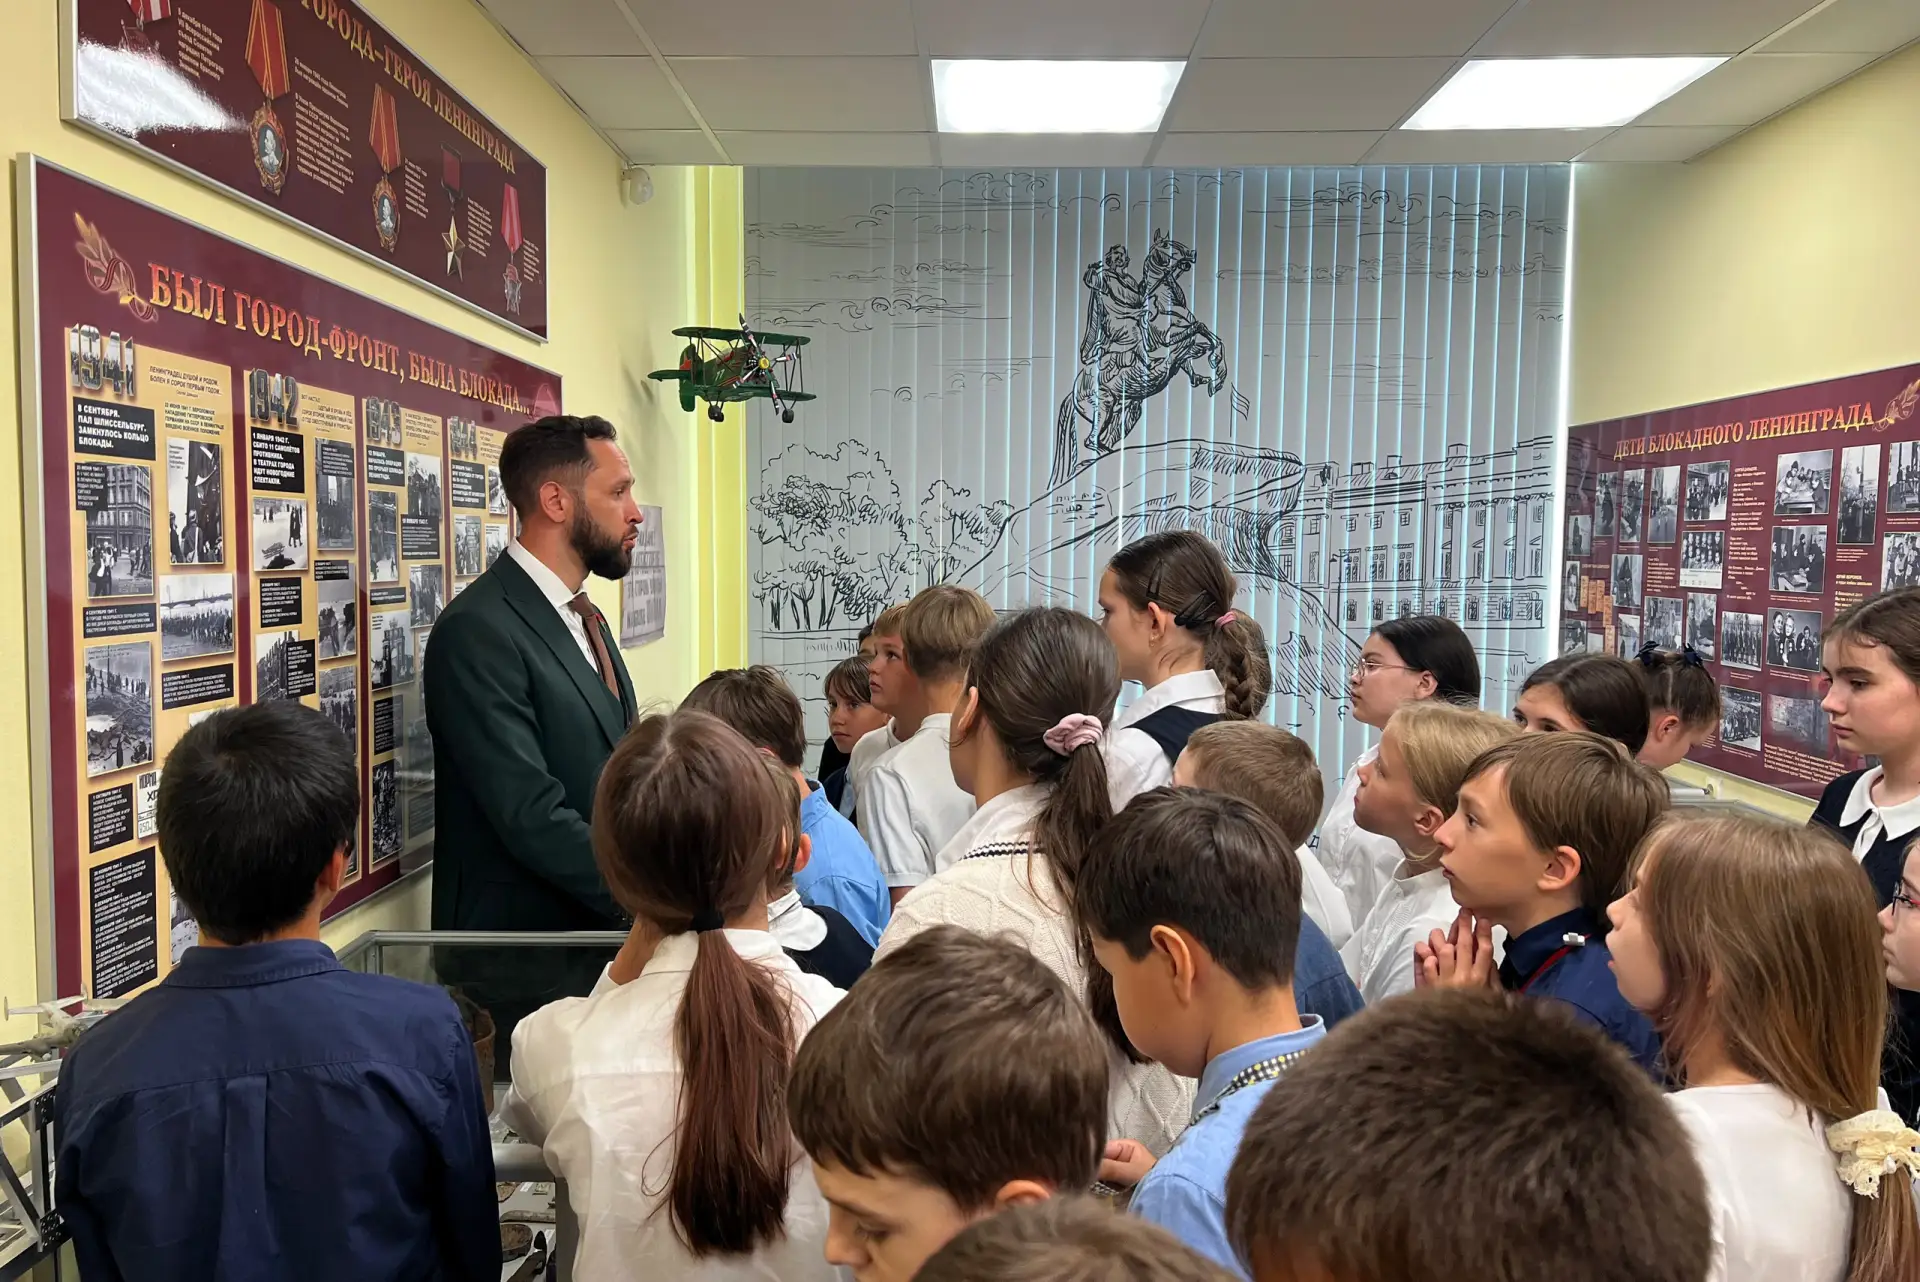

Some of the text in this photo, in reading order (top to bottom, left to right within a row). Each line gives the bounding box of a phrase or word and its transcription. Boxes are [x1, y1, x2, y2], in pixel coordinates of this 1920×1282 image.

[434, 88, 516, 174] ЛЕНИНГРАДА
[148, 261, 227, 326] БЫЛ
[234, 290, 404, 385] ГОРОД-ФРОНТ,
[409, 353, 456, 394] БЫЛА
[70, 323, 135, 397] 1941
[84, 405, 120, 418] СЕНТЯБРЯ.
[249, 368, 298, 427] 1942
[78, 415, 147, 432] ПАЛ ШЛИССЕЛЬБУРГ.
[78, 426, 149, 443] ЗАМКНУЛОСЬ КОЛЬЦО
[79, 436, 114, 448] БЛОКАДЫ.
[1614, 402, 1875, 461] ДЕТИ БЛОКАДНОГО ЛЕНИНГРАДА
[278, 462, 295, 470] ГОРОДА
